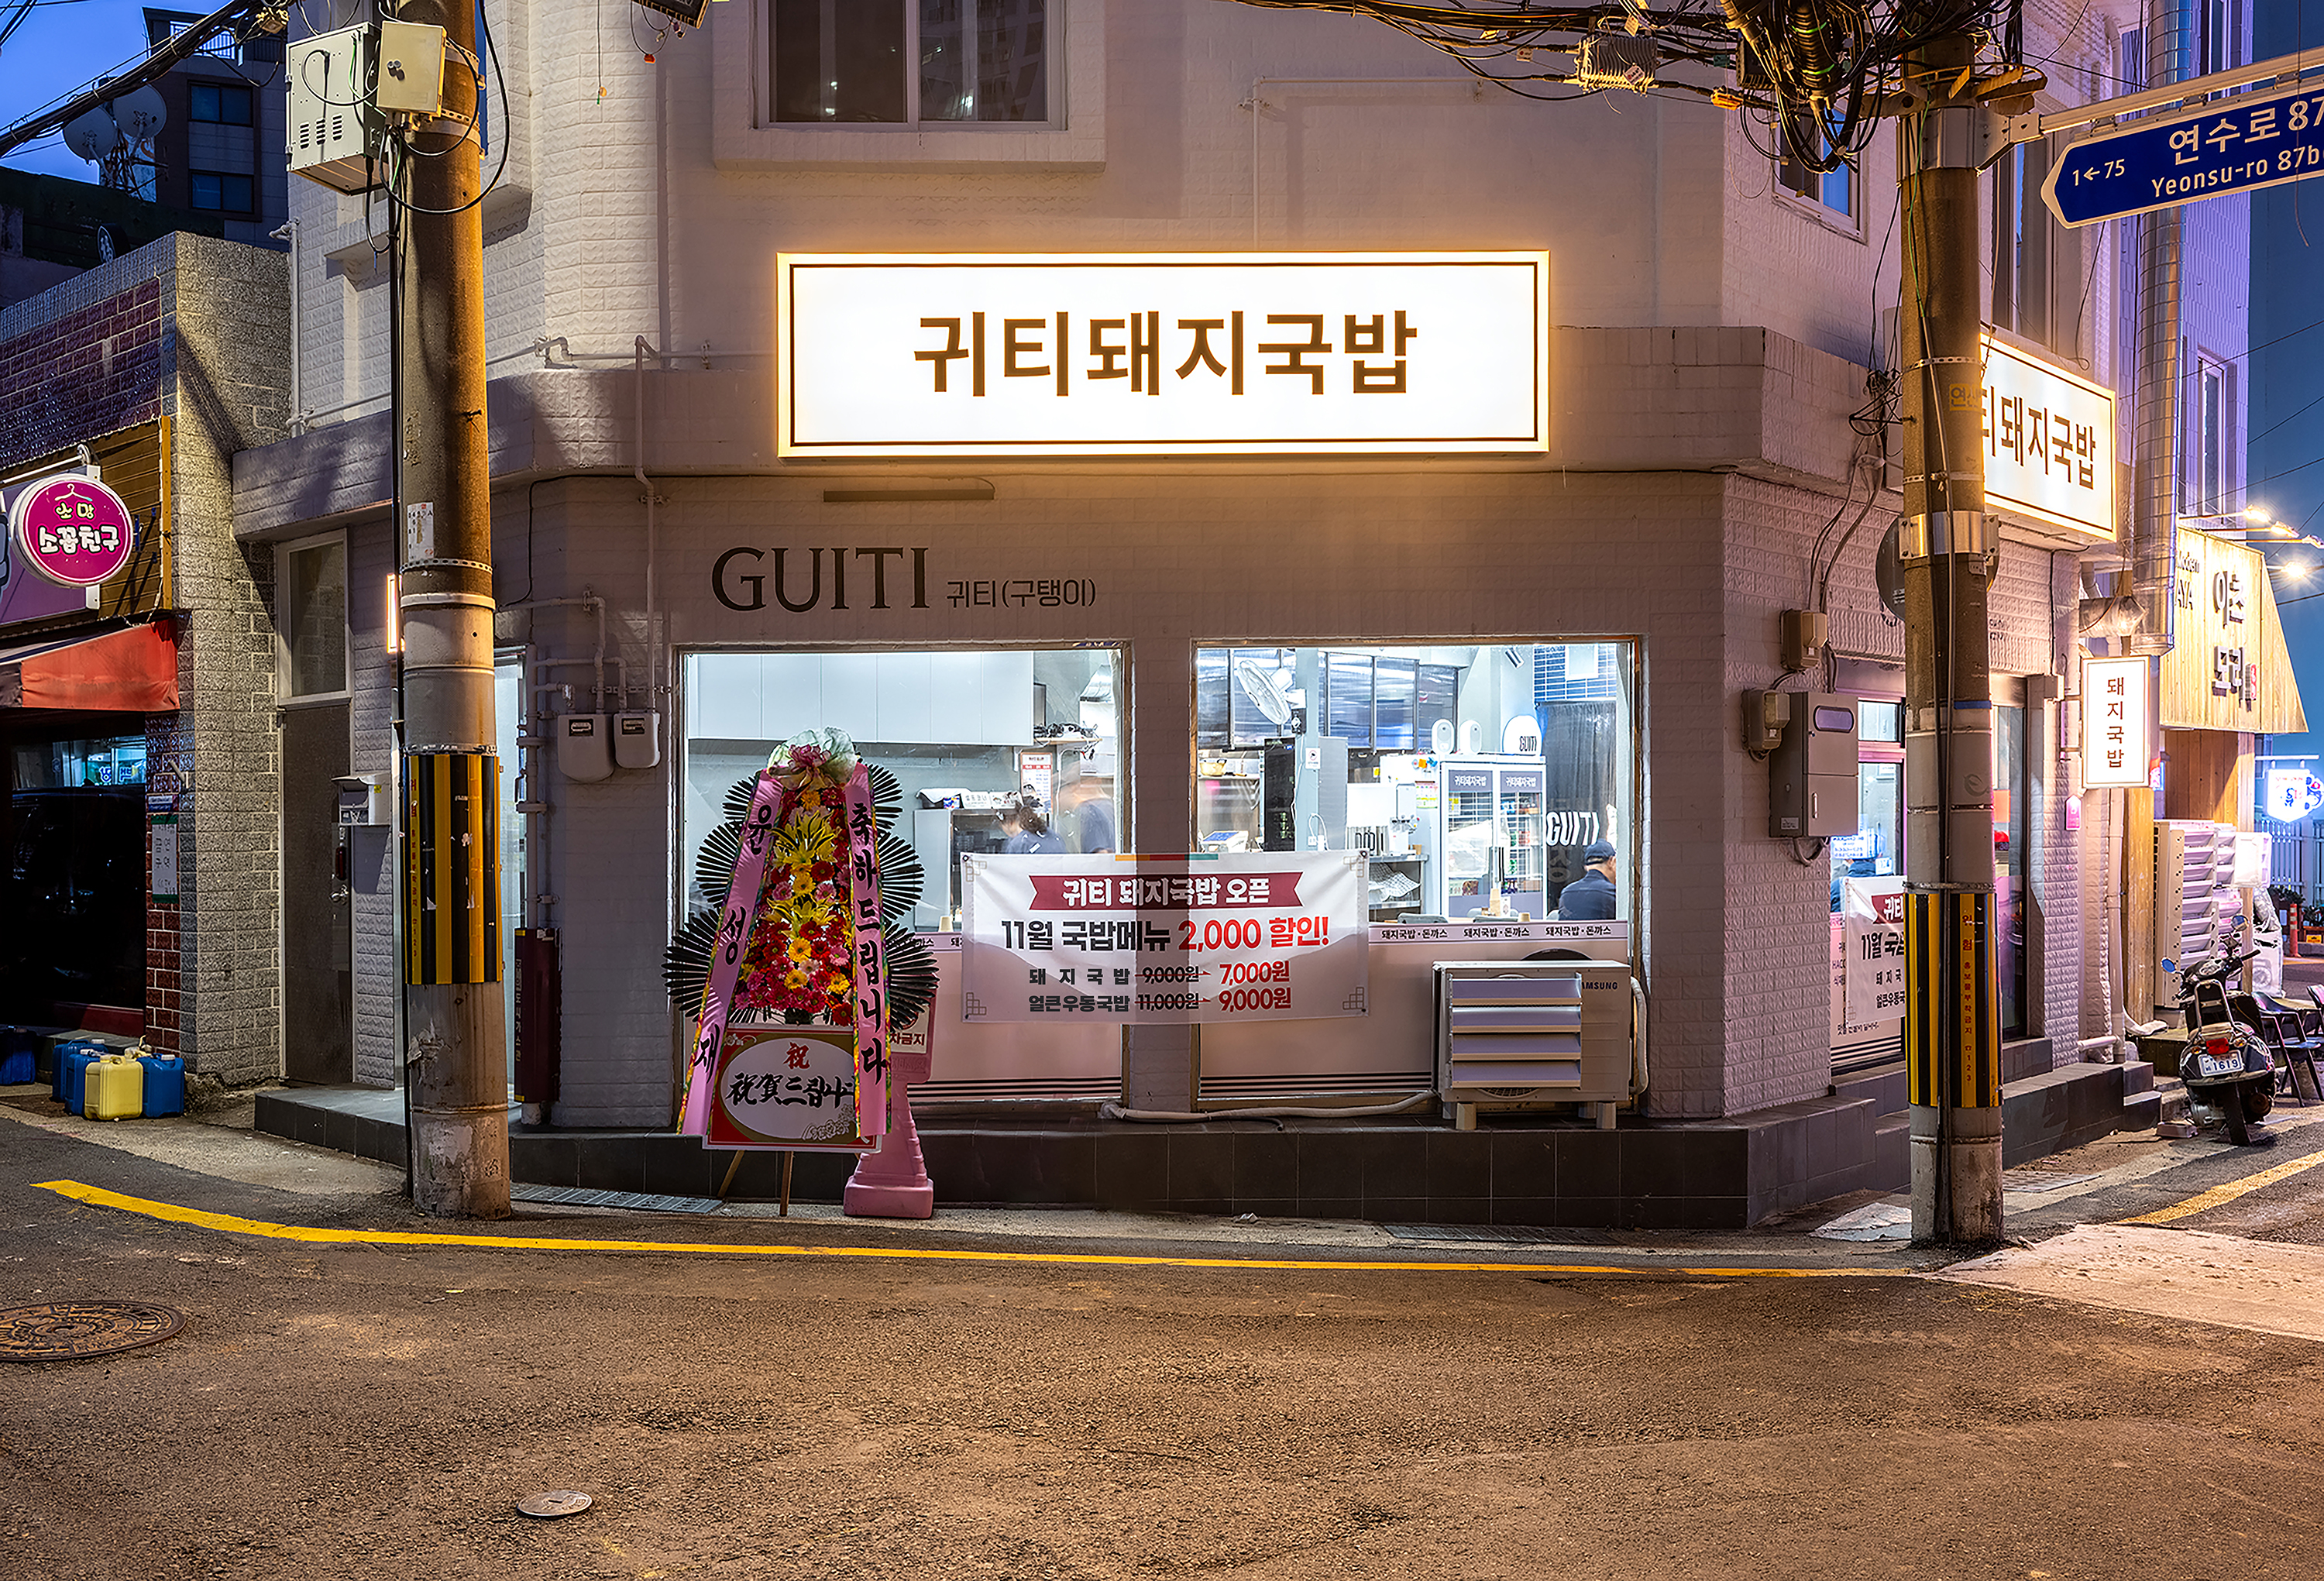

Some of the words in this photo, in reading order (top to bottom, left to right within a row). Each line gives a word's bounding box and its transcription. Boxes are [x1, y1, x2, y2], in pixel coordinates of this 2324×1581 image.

[2169, 108, 2280, 166] 연수로
[2072, 170, 2079, 186] 1
[2104, 159, 2126, 179] 75
[2151, 159, 2267, 198] Yeonsu-ro
[2278, 145, 2324, 171] 87b
[914, 309, 1418, 397] 귀티돼지국밥
[711, 547, 929, 613] GUITI
[2174, 579, 2194, 610] AYA
[2106, 676, 2125, 768] 돼지국밥
[1519, 735, 1537, 751] GUITI
[1546, 811, 1600, 847] GUITI
[1062, 878, 1113, 907] 귀티
[1119, 876, 1222, 907] 돼지국밥
[1226, 878, 1270, 905] 오픈
[849, 803, 887, 1085] 축하드립니다
[1001, 920, 1053, 951] 11월
[1060, 920, 1171, 951] 국밥메뉴
[1177, 919, 1262, 953] 2,000
[1268, 916, 1329, 948] 할인!
[1862, 932, 1882, 960] 11월
[1142, 966, 1199, 985] 9,000원
[1219, 961, 1291, 985] 7,000원
[1581, 981, 1618, 990] AMSUNG
[1029, 995, 1130, 1012] 얼큰우동국밥
[1138, 993, 1200, 1012] 11,000원
[1219, 988, 1291, 1012] 9,000원
[1876, 991, 1905, 1009] 얼큰우동국
[890, 1033, 926, 1046] 차금지
[782, 1041, 810, 1070] 祝
[2213, 1059, 2238, 1071] 1619
